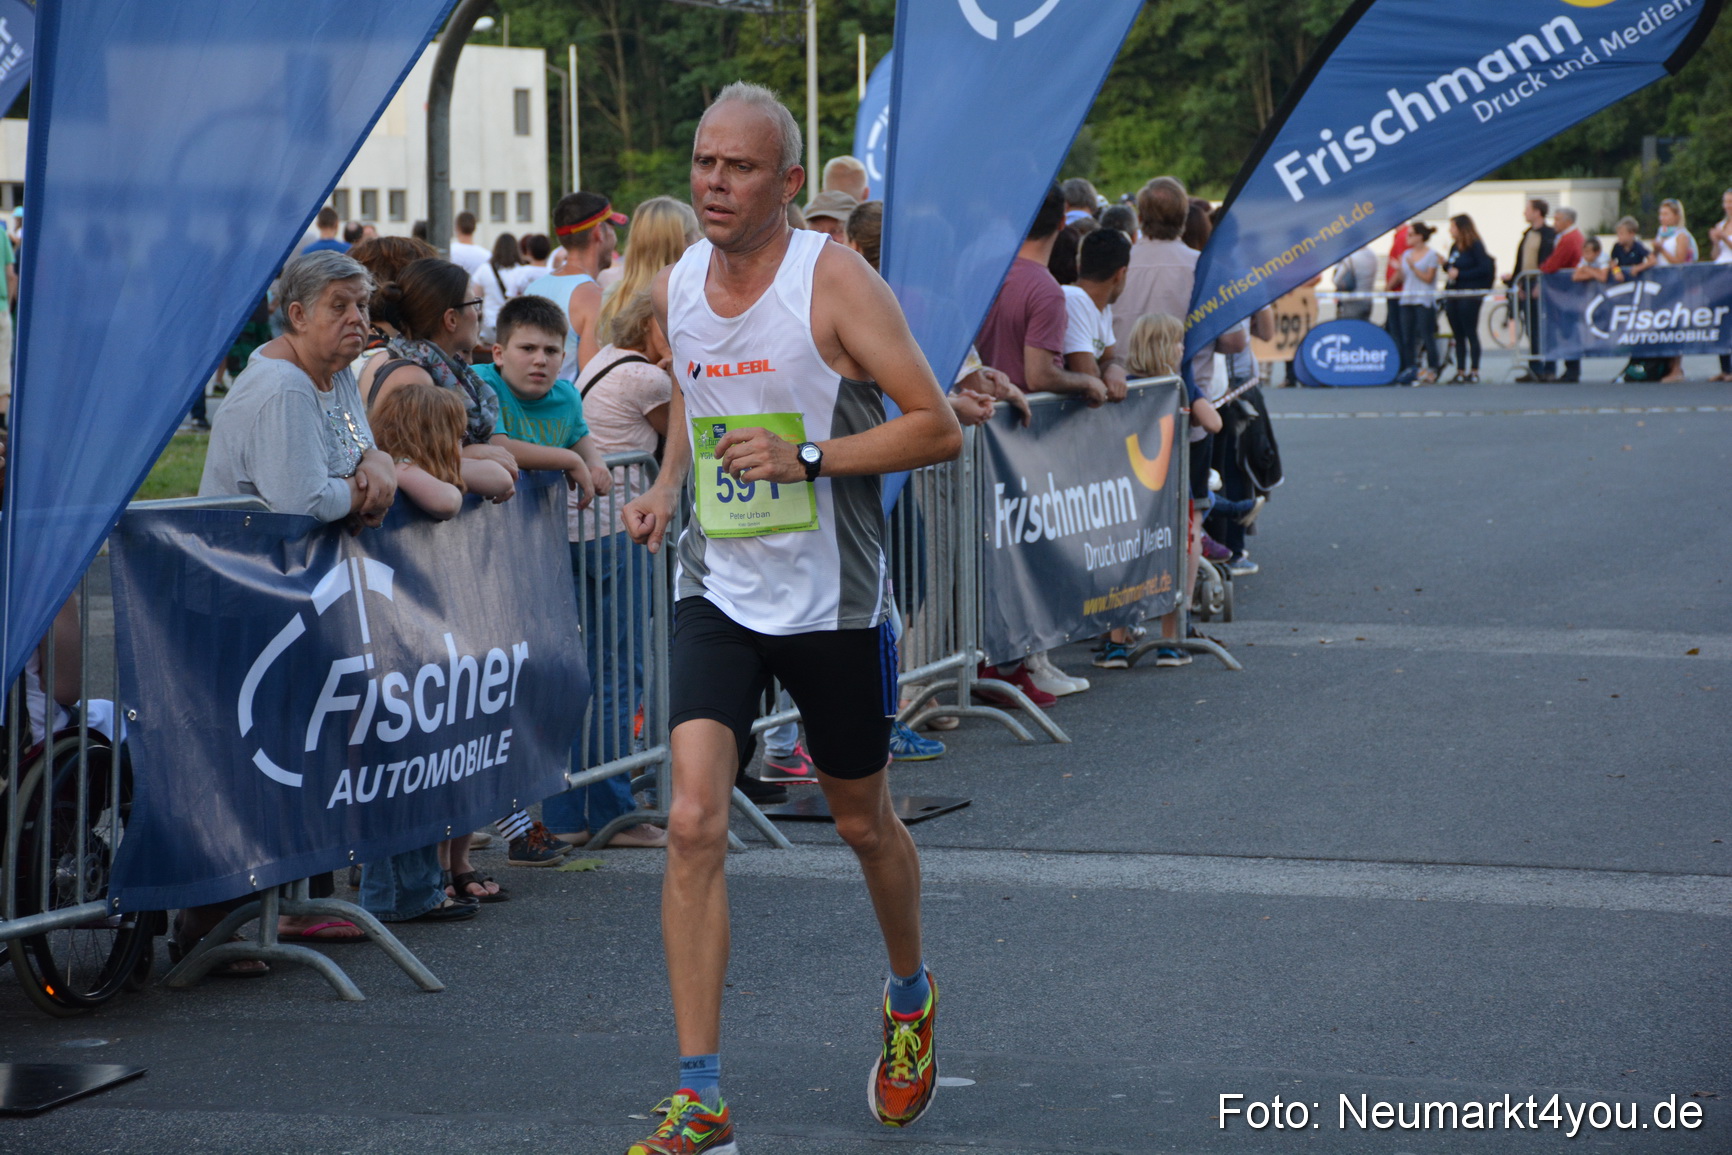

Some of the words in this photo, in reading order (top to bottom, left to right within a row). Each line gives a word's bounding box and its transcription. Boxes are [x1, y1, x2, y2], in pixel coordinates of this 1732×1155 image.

[1472, 72, 1547, 123] Druck
[1550, 46, 1600, 80] und
[1273, 15, 1584, 202] Frischmann
[1609, 302, 1729, 332] Fischer
[1617, 329, 1720, 345] AUTOMOBILE
[706, 359, 776, 378] KLEBL
[1326, 347, 1388, 364] Fischer
[729, 512, 745, 520] Peter
[746, 510, 771, 519] Urban
[994, 472, 1137, 549] Frischmann
[1084, 535, 1117, 571] Druck
[1118, 528, 1140, 563] und
[304, 632, 529, 752] Fischer
[326, 728, 513, 809] AUTOMOBILE
